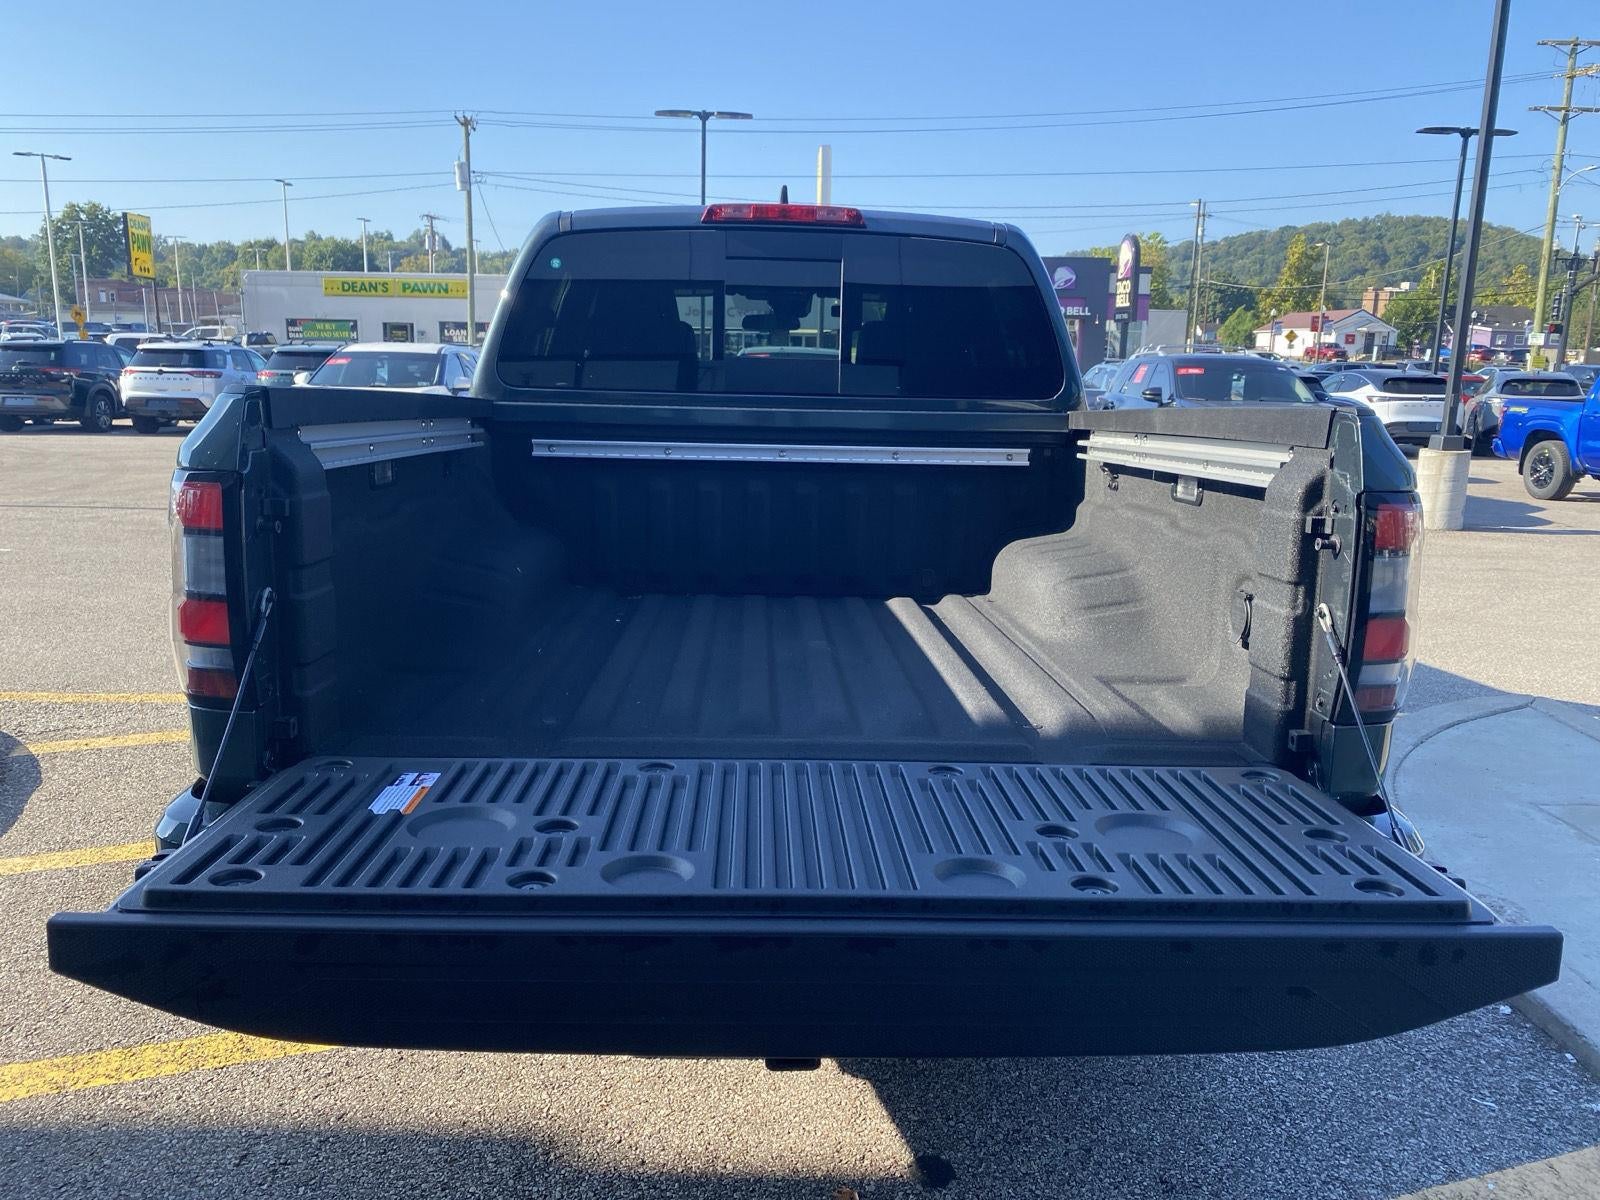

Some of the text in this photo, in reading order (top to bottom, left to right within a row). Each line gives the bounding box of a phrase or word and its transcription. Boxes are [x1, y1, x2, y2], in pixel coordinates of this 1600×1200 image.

[131, 232, 152, 254] PAWN
[341, 281, 449, 294] DEAN'S PAWN
[1116, 280, 1131, 294] TACO
[1115, 294, 1130, 308] BELL
[1066, 306, 1091, 316] BELL
